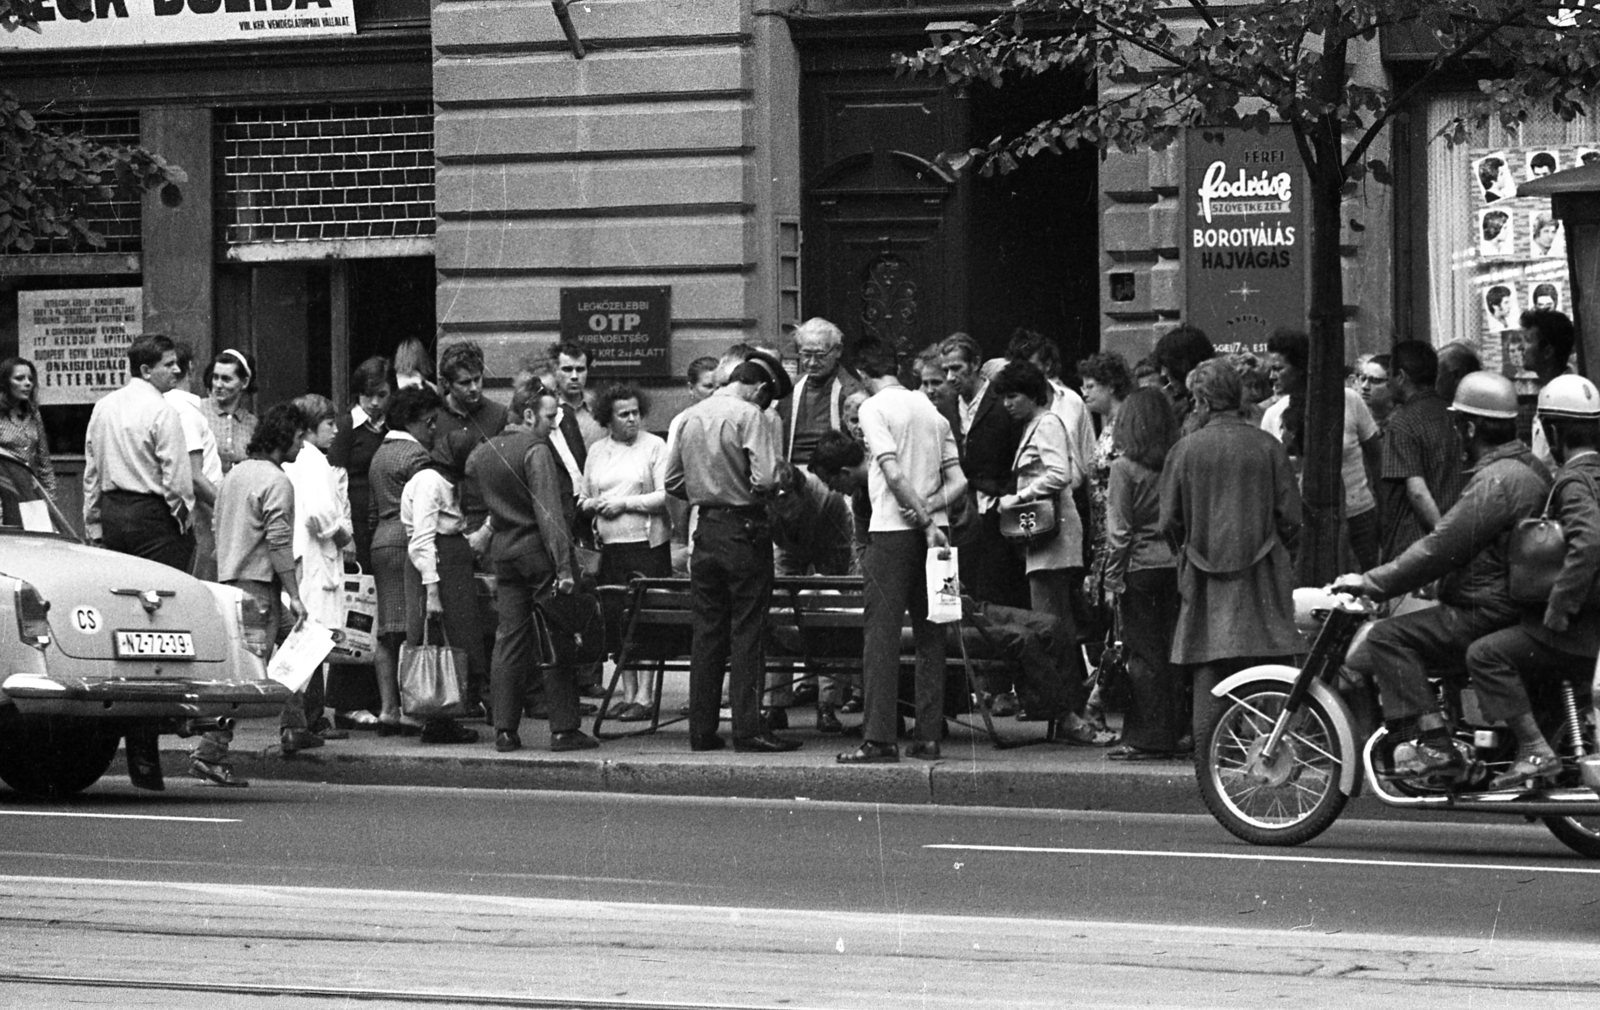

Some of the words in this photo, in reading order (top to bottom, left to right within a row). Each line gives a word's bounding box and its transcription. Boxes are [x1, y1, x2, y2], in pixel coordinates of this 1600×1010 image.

[1193, 221, 1296, 247] BOROTVÁLÁS
[1202, 247, 1290, 269] HAJVÁGÁS
[578, 300, 650, 311] LEGKÖZELEBBI
[588, 313, 641, 331] OTP
[578, 332, 650, 343] KIRENDELTSÉG
[634, 348, 666, 358] ALATT
[77, 609, 97, 630] CS
